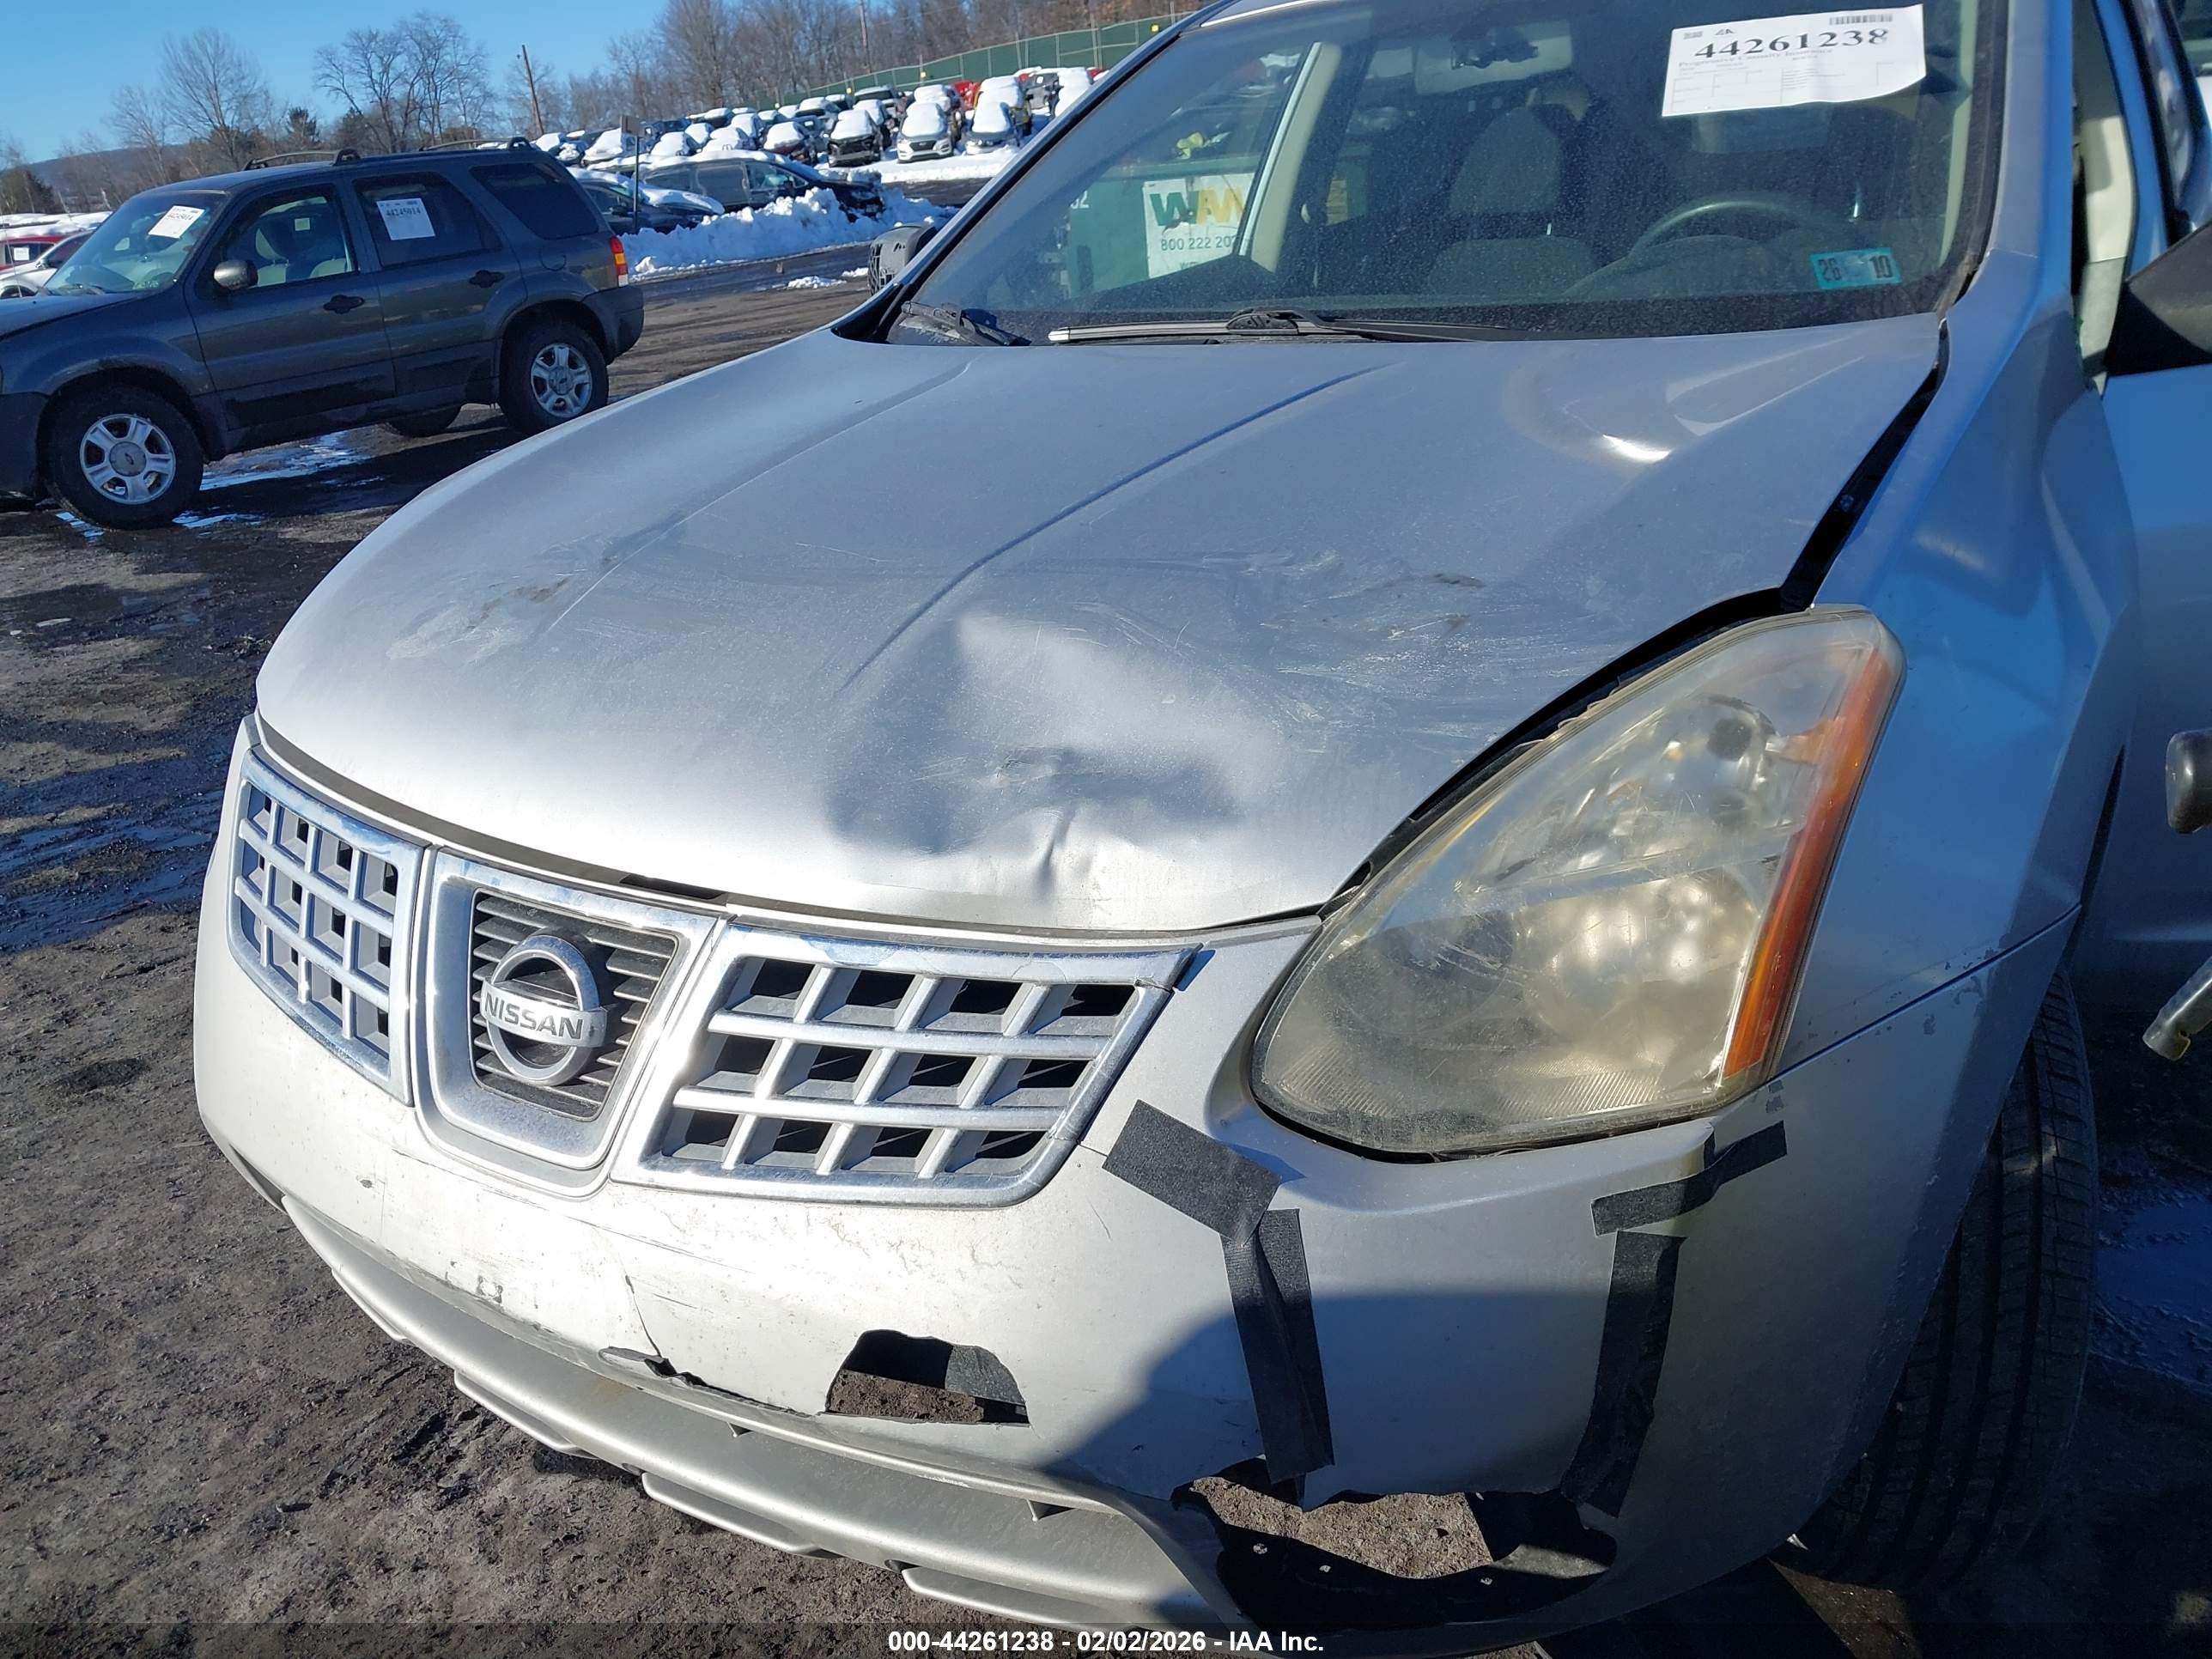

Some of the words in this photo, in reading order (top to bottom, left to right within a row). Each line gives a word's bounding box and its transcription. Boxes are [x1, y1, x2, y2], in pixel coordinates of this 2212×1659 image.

[1694, 28, 1888, 58] 44261238
[1161, 238, 1184, 251] 800
[1188, 237, 1212, 249] 222
[484, 993, 583, 1040] NISSAN
